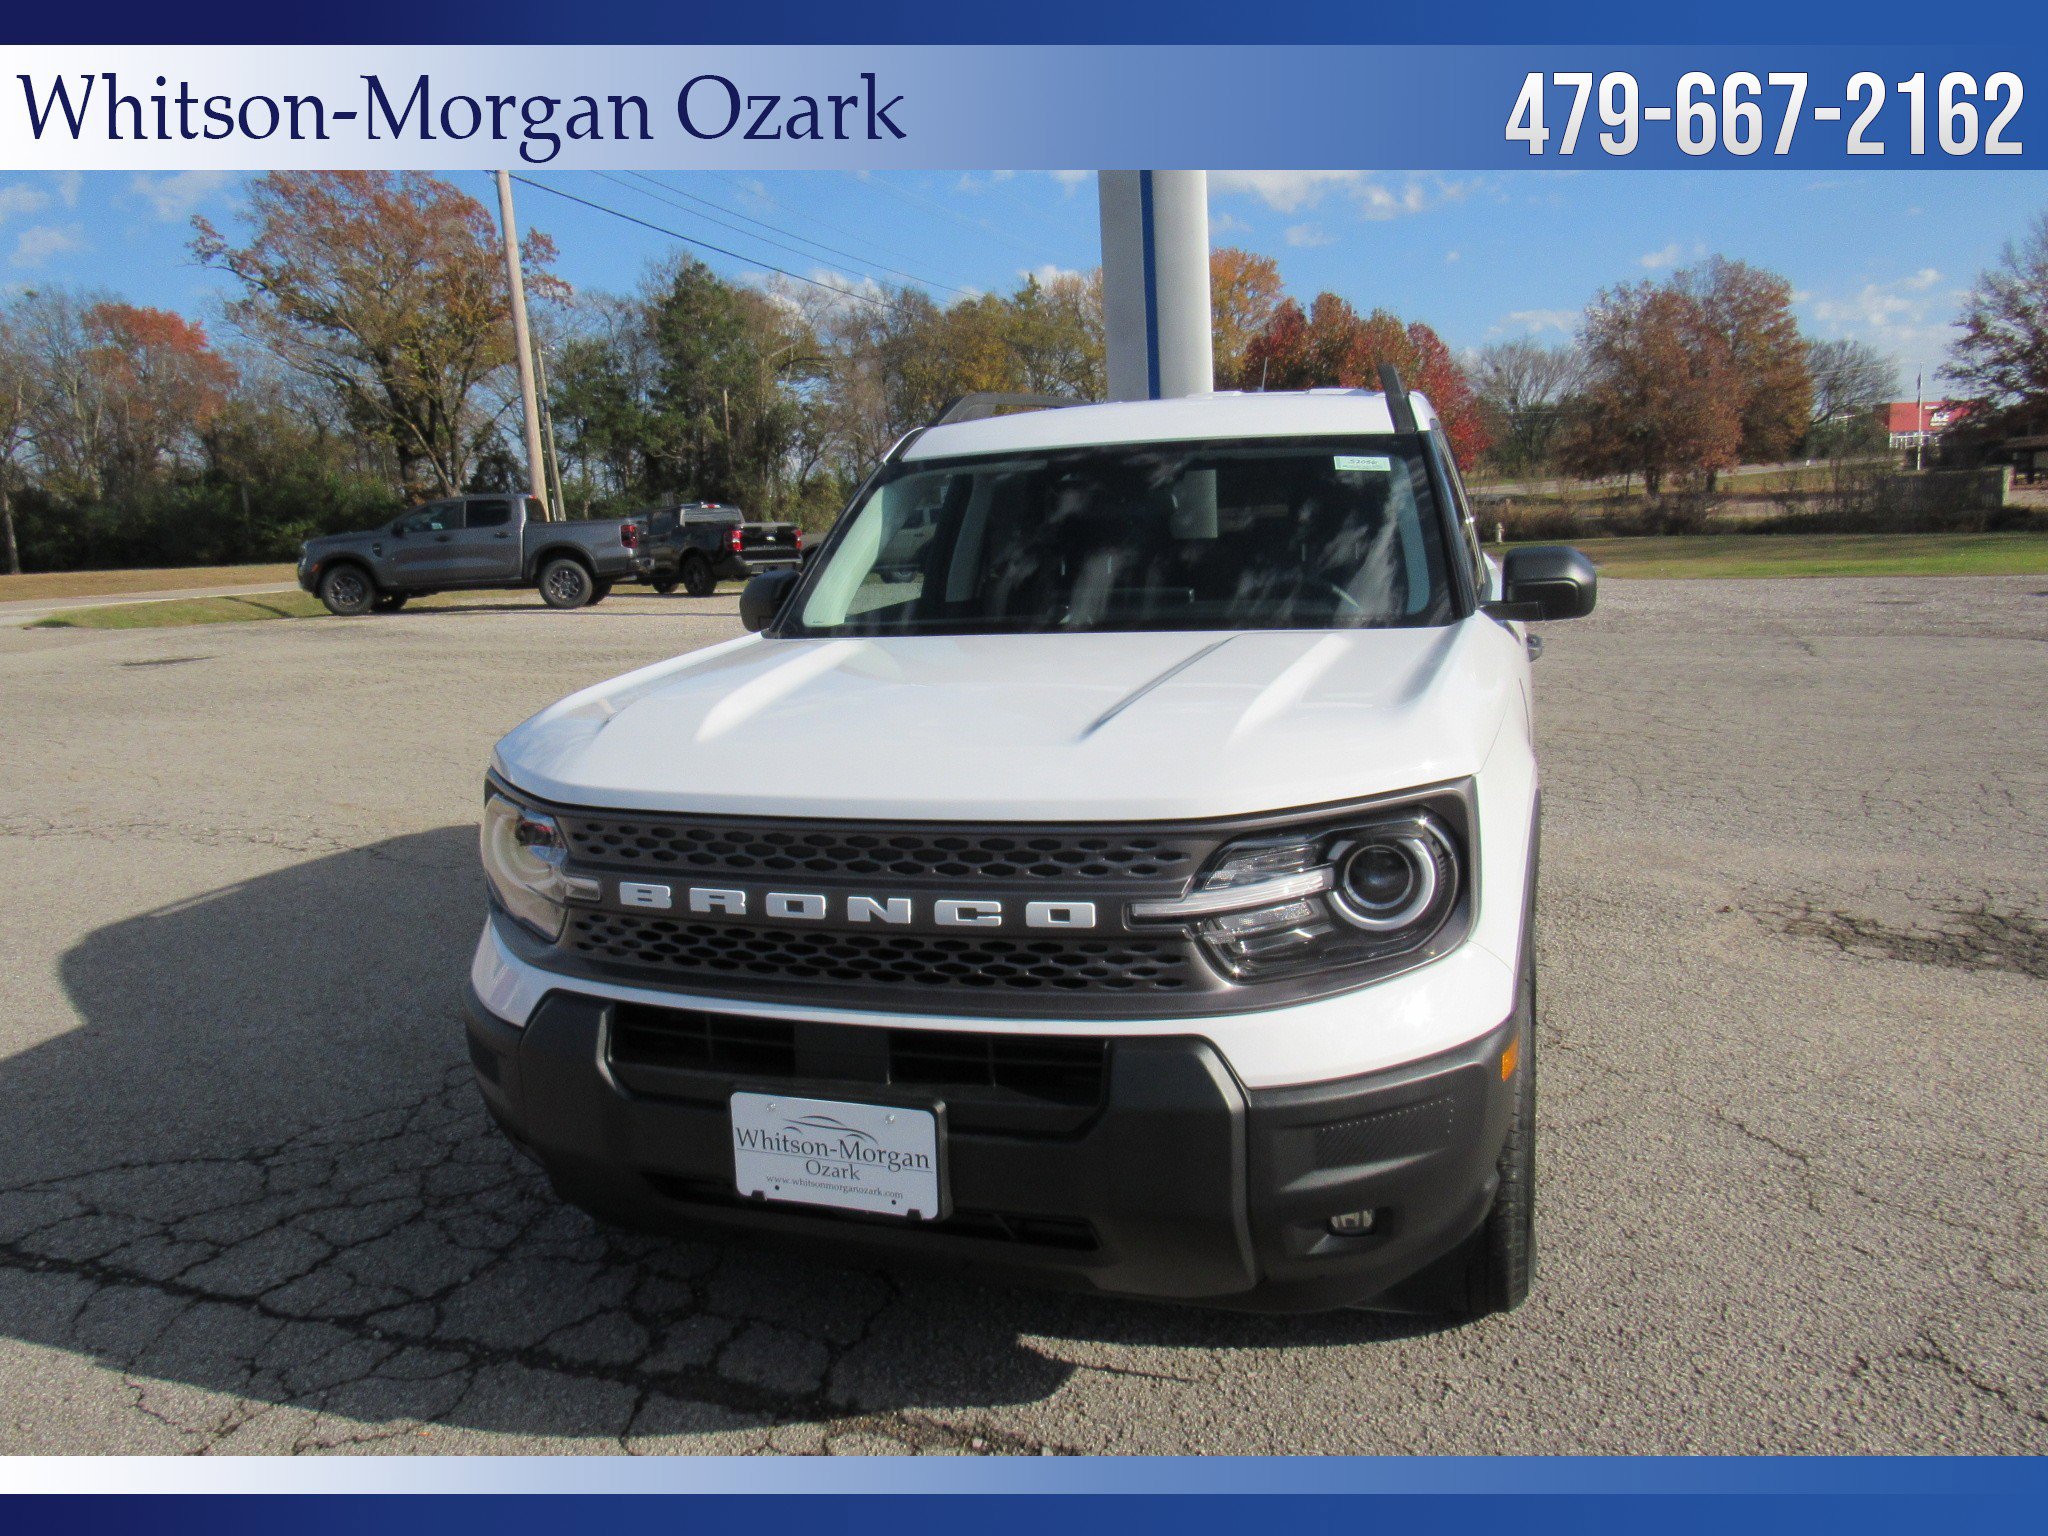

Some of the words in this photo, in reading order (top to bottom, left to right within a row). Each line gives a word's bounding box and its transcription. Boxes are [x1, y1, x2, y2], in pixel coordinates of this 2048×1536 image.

[619, 881, 1096, 928] BRONCO
[735, 1126, 930, 1173] Whitson-Morgan
[766, 1174, 904, 1200] www.whitsonmorganozark.com
[805, 1159, 861, 1181] Ozark
